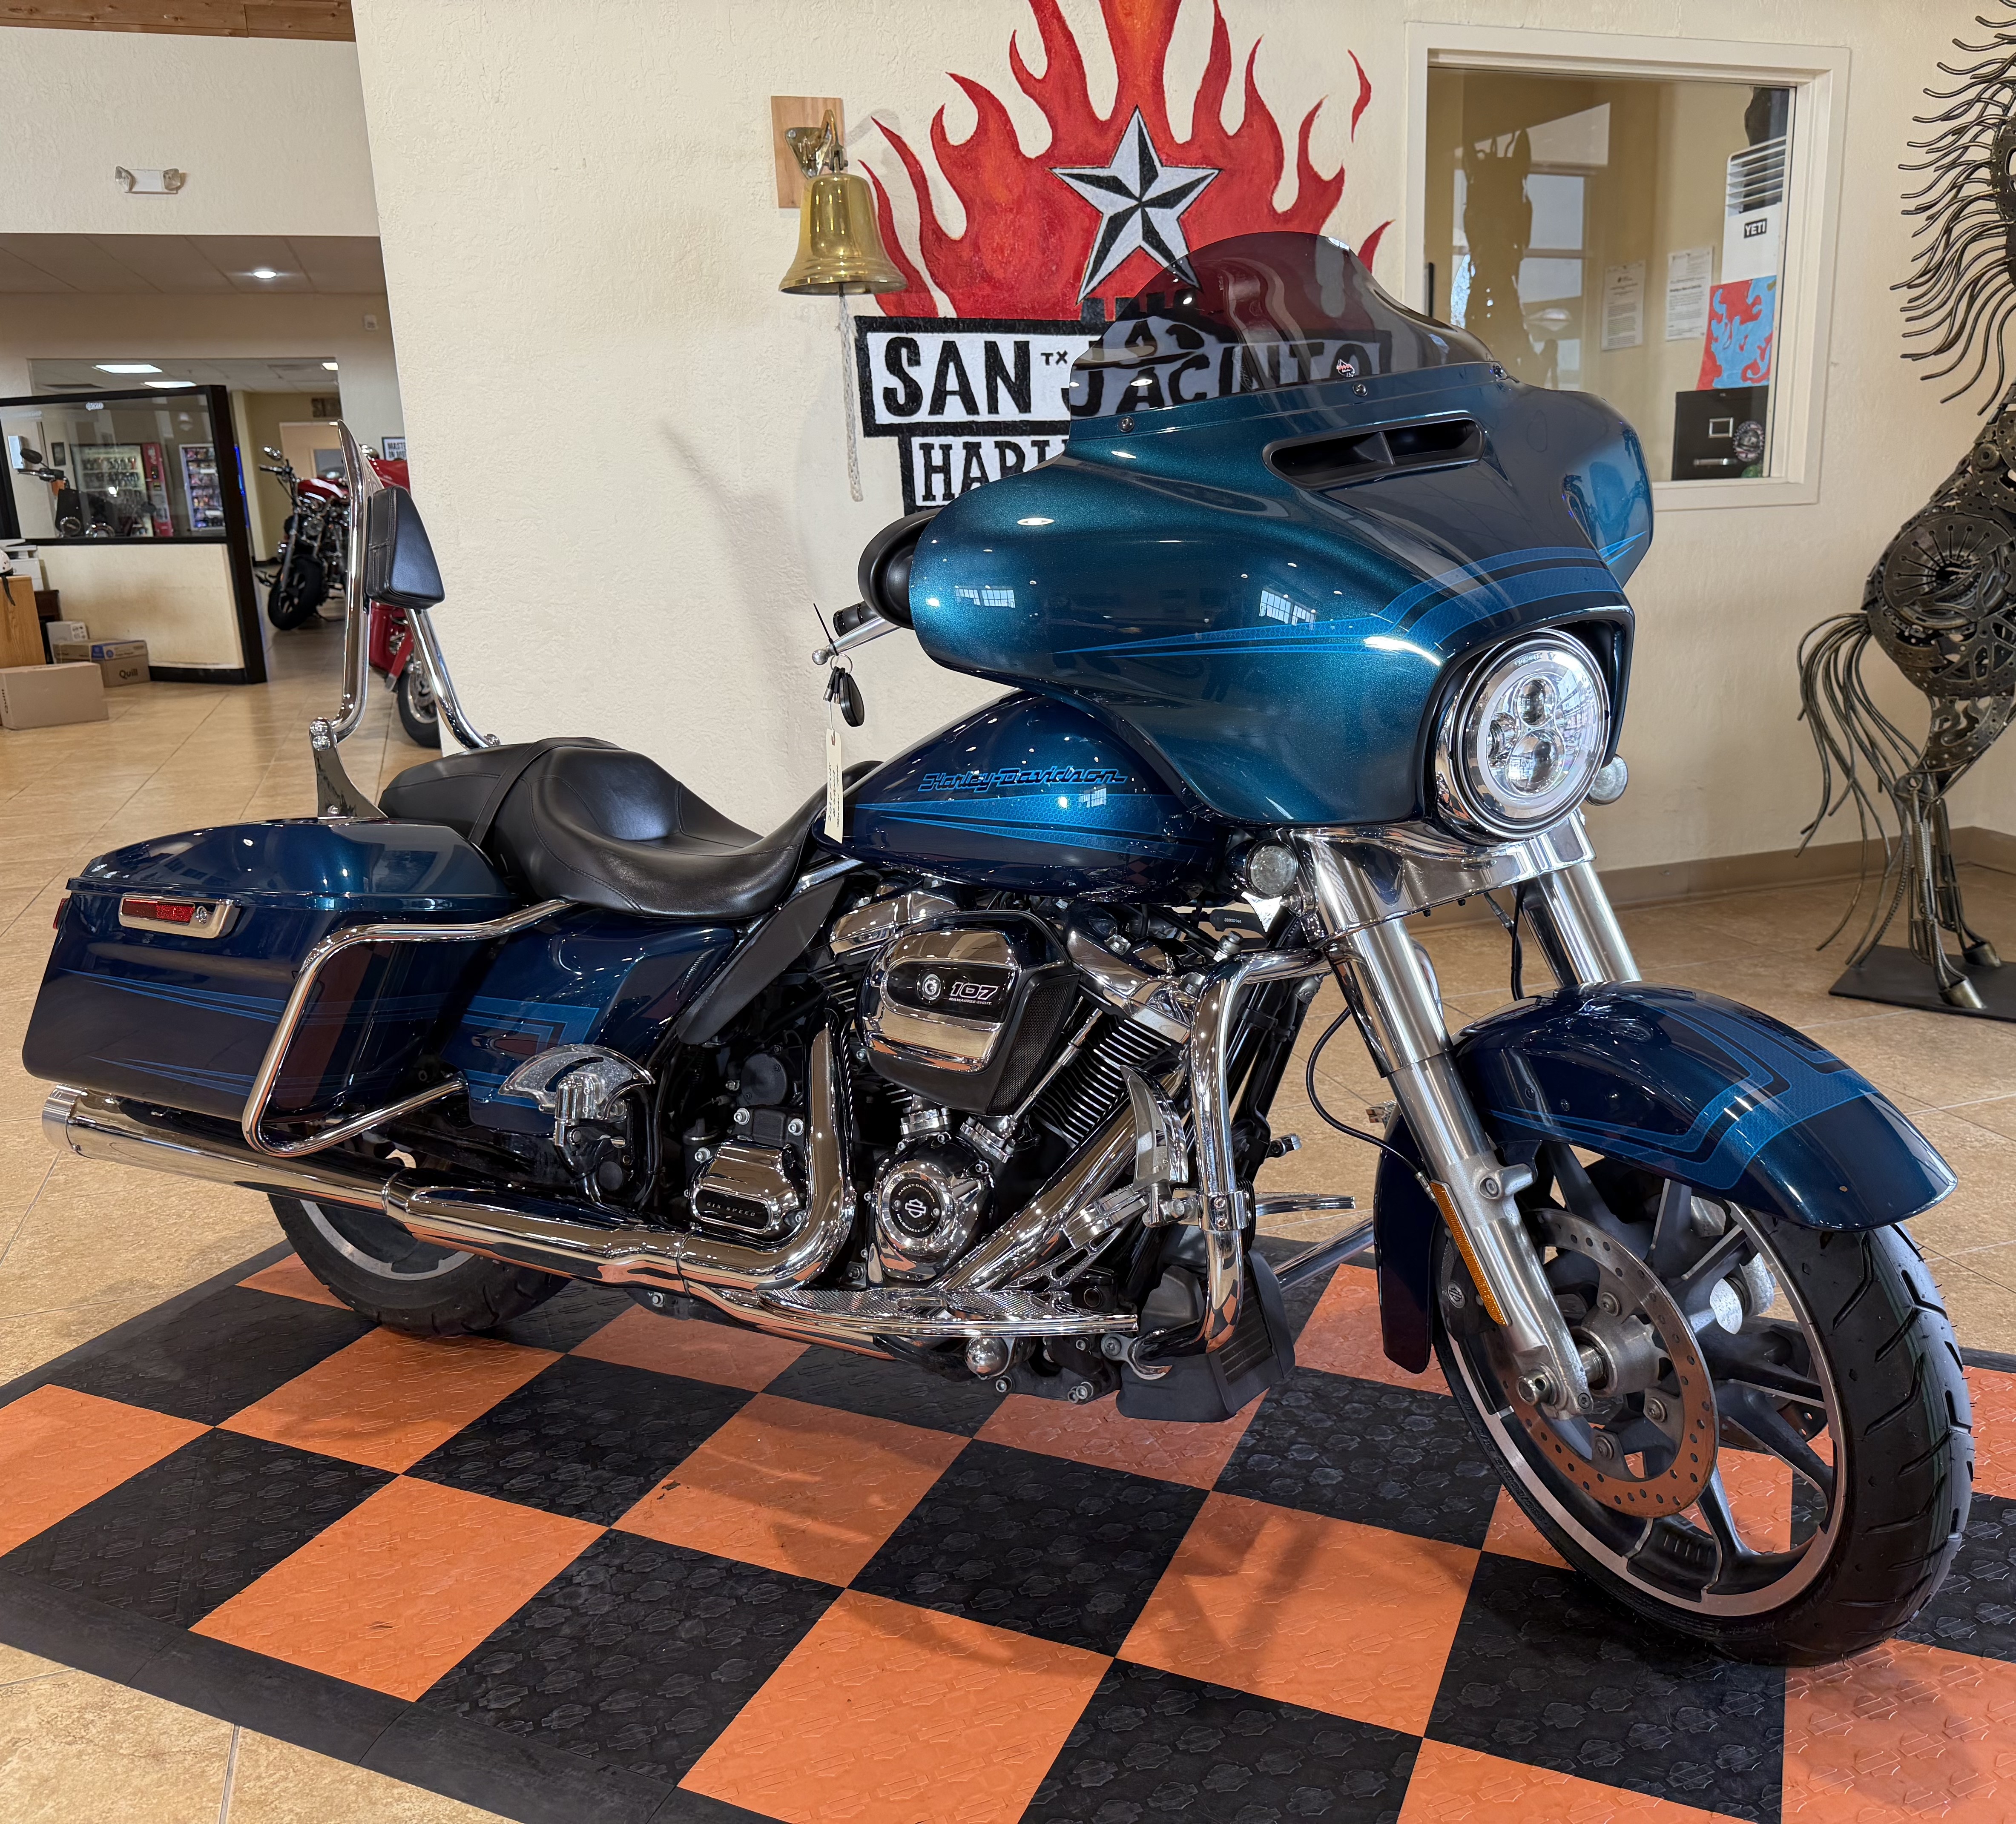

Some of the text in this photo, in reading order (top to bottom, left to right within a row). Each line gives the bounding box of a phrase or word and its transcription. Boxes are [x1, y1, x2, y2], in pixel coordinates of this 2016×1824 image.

[1745, 221, 1766, 236] YETI
[1040, 350, 1068, 365] TX
[882, 320, 1373, 417] SAN JACINTO
[119, 668, 138, 680] Quill
[918, 766, 1128, 793] Harley-Davidson
[950, 982, 1000, 1000] 107
[726, 1206, 755, 1216] SPEED
